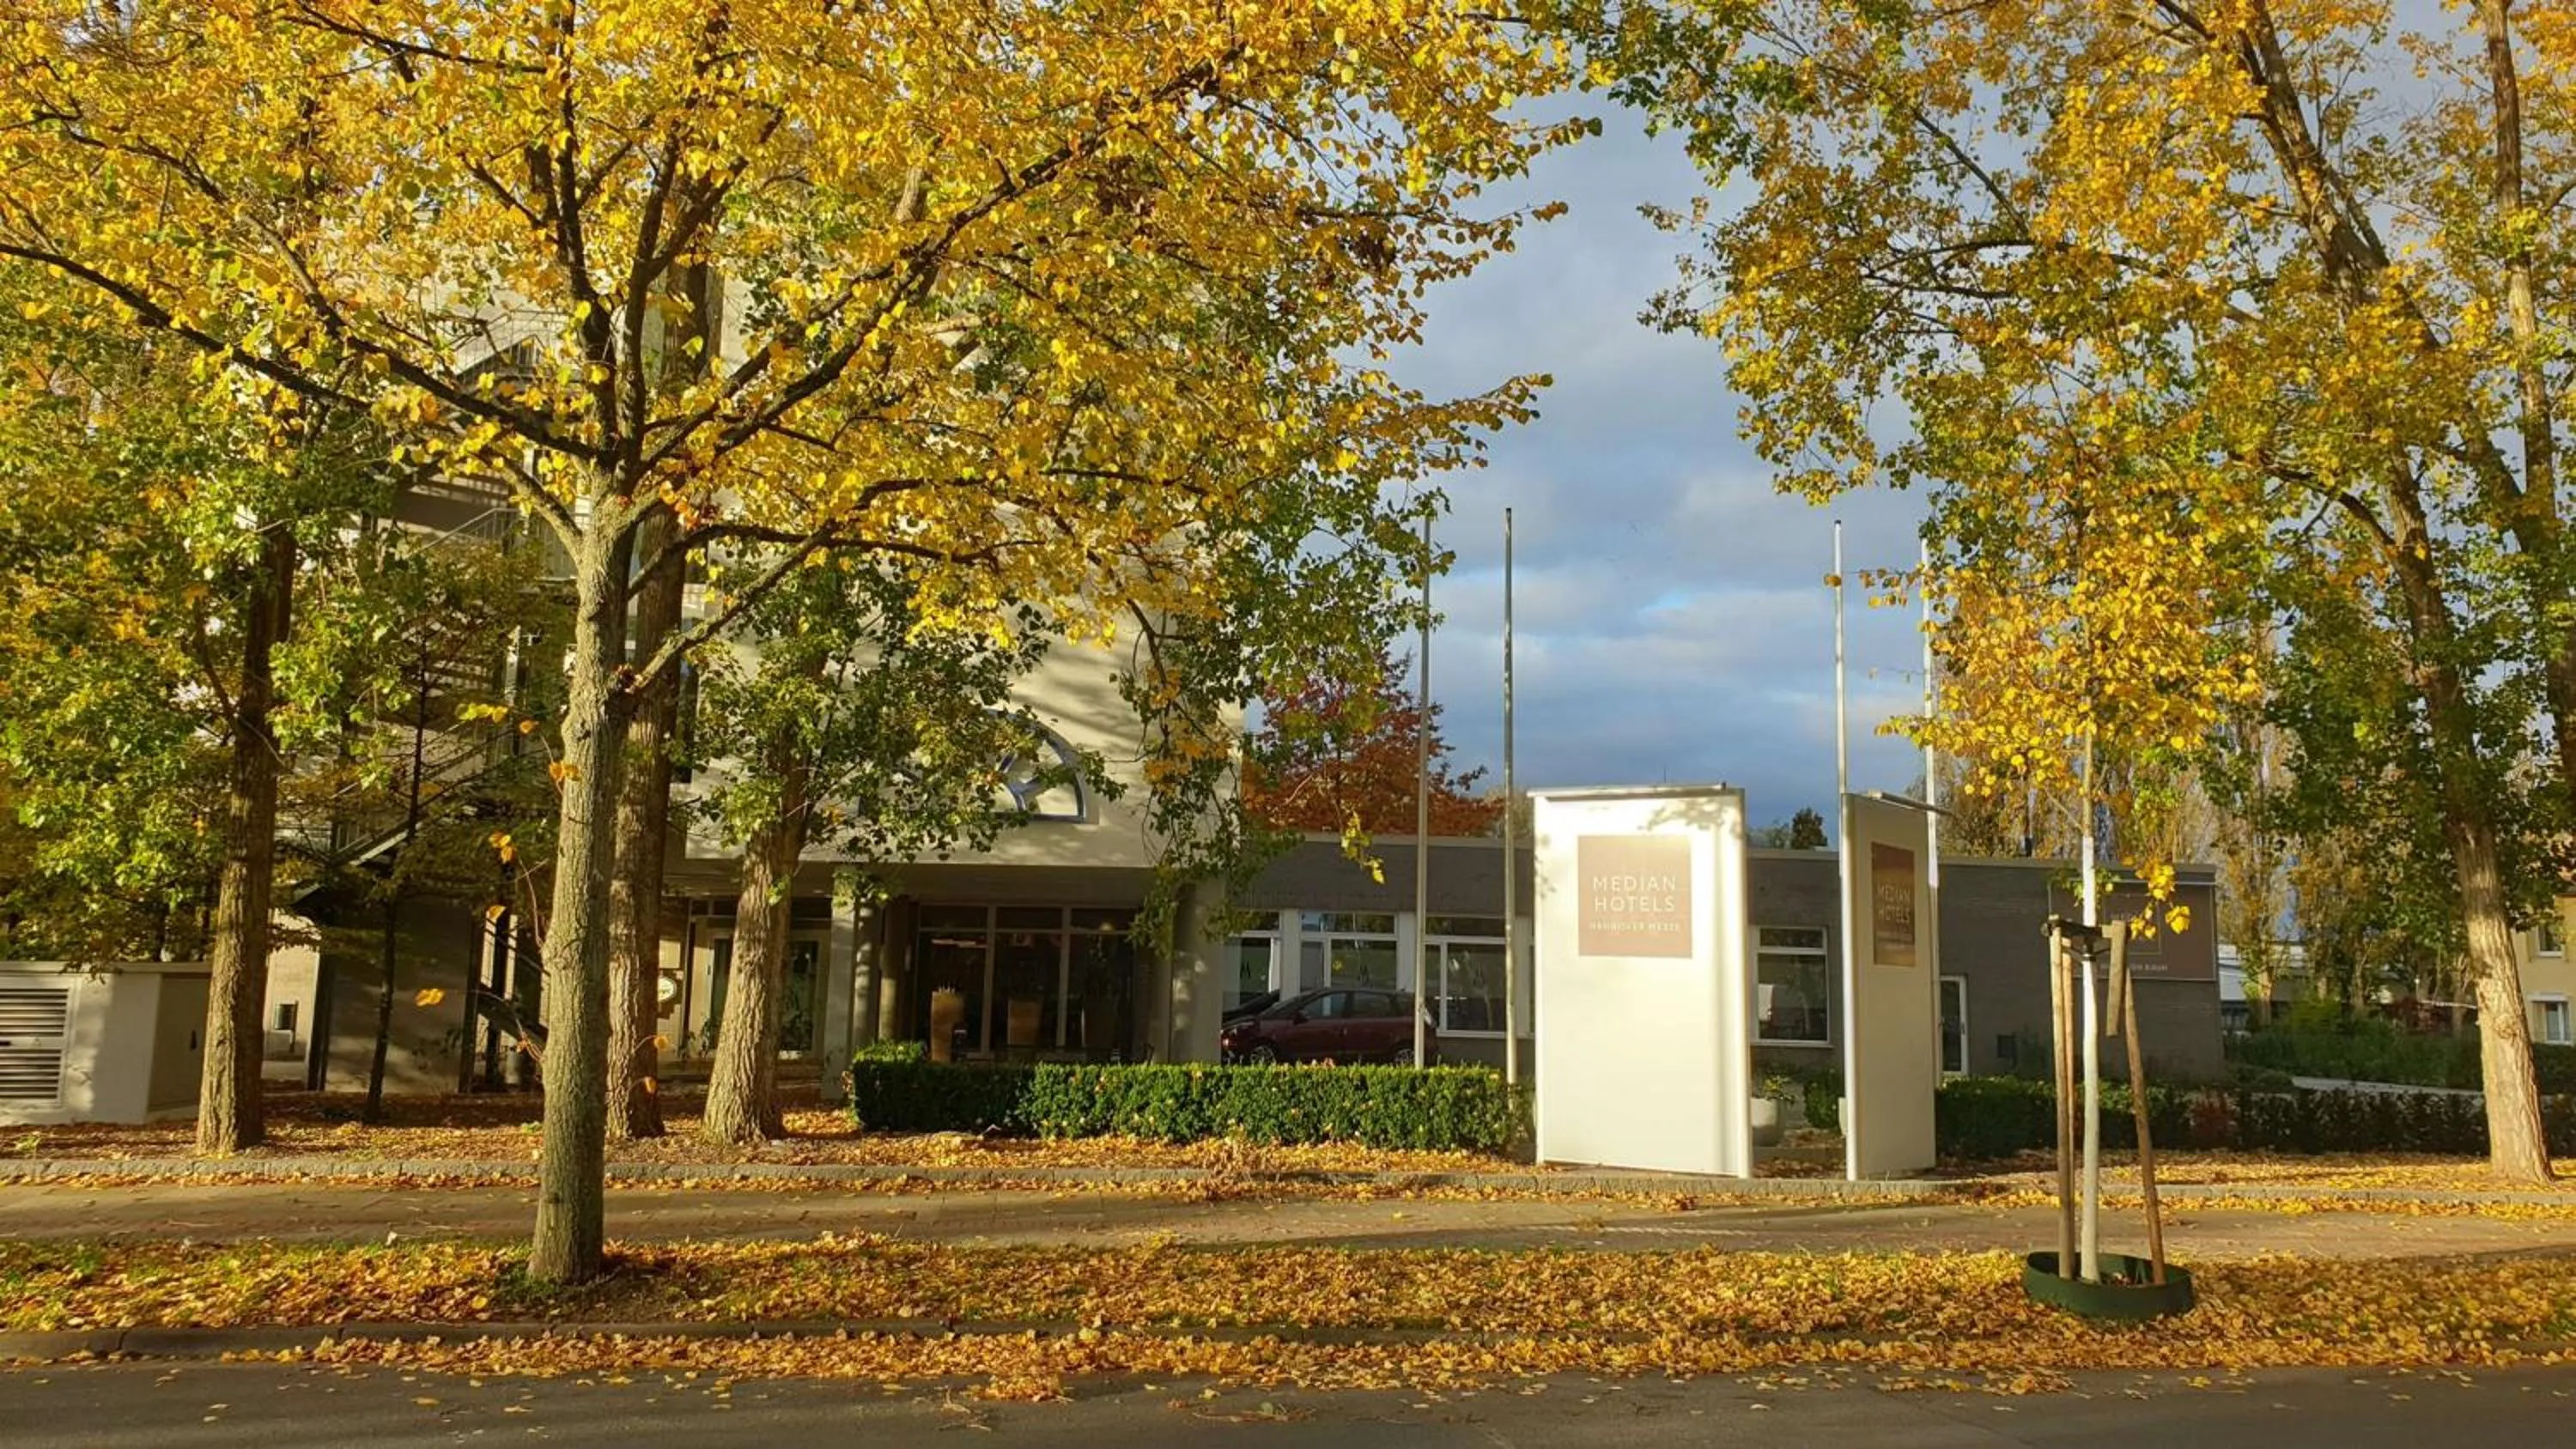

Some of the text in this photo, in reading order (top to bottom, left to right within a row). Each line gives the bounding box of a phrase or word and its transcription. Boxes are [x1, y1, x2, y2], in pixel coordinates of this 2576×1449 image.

[1593, 876, 1675, 892] MEDIAN
[1595, 895, 1674, 912] HOTELS
[1877, 884, 1911, 905] MEDIAN
[1878, 905, 1911, 924] HOTELS
